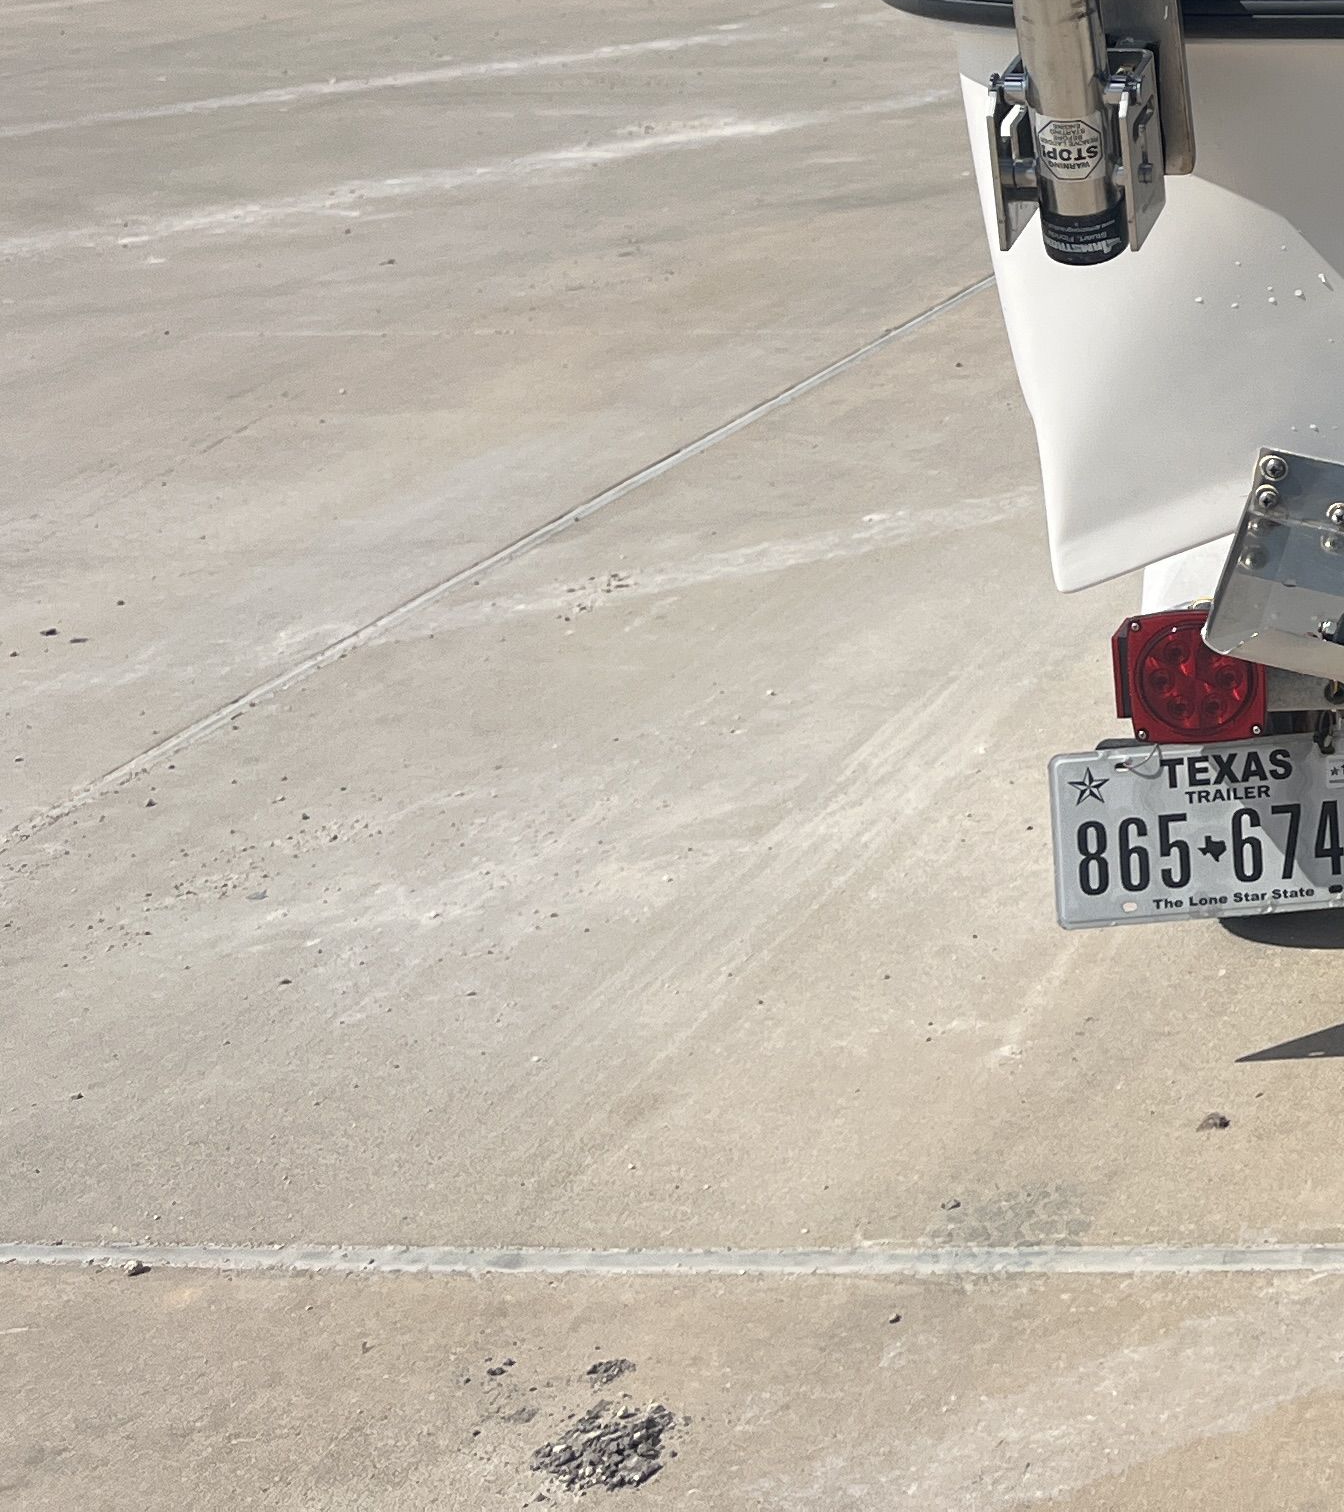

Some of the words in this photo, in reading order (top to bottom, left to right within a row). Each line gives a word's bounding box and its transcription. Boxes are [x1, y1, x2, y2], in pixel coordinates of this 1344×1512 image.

[1041, 145, 1098, 161] STOP!
[1160, 748, 1294, 789] TEXAS
[1184, 785, 1271, 805] TRAILER
[1076, 812, 1192, 896] 865
[1153, 897, 1184, 910] The
[1188, 893, 1229, 906] Lone
[1233, 890, 1267, 904] Star
[1271, 887, 1315, 901] State
